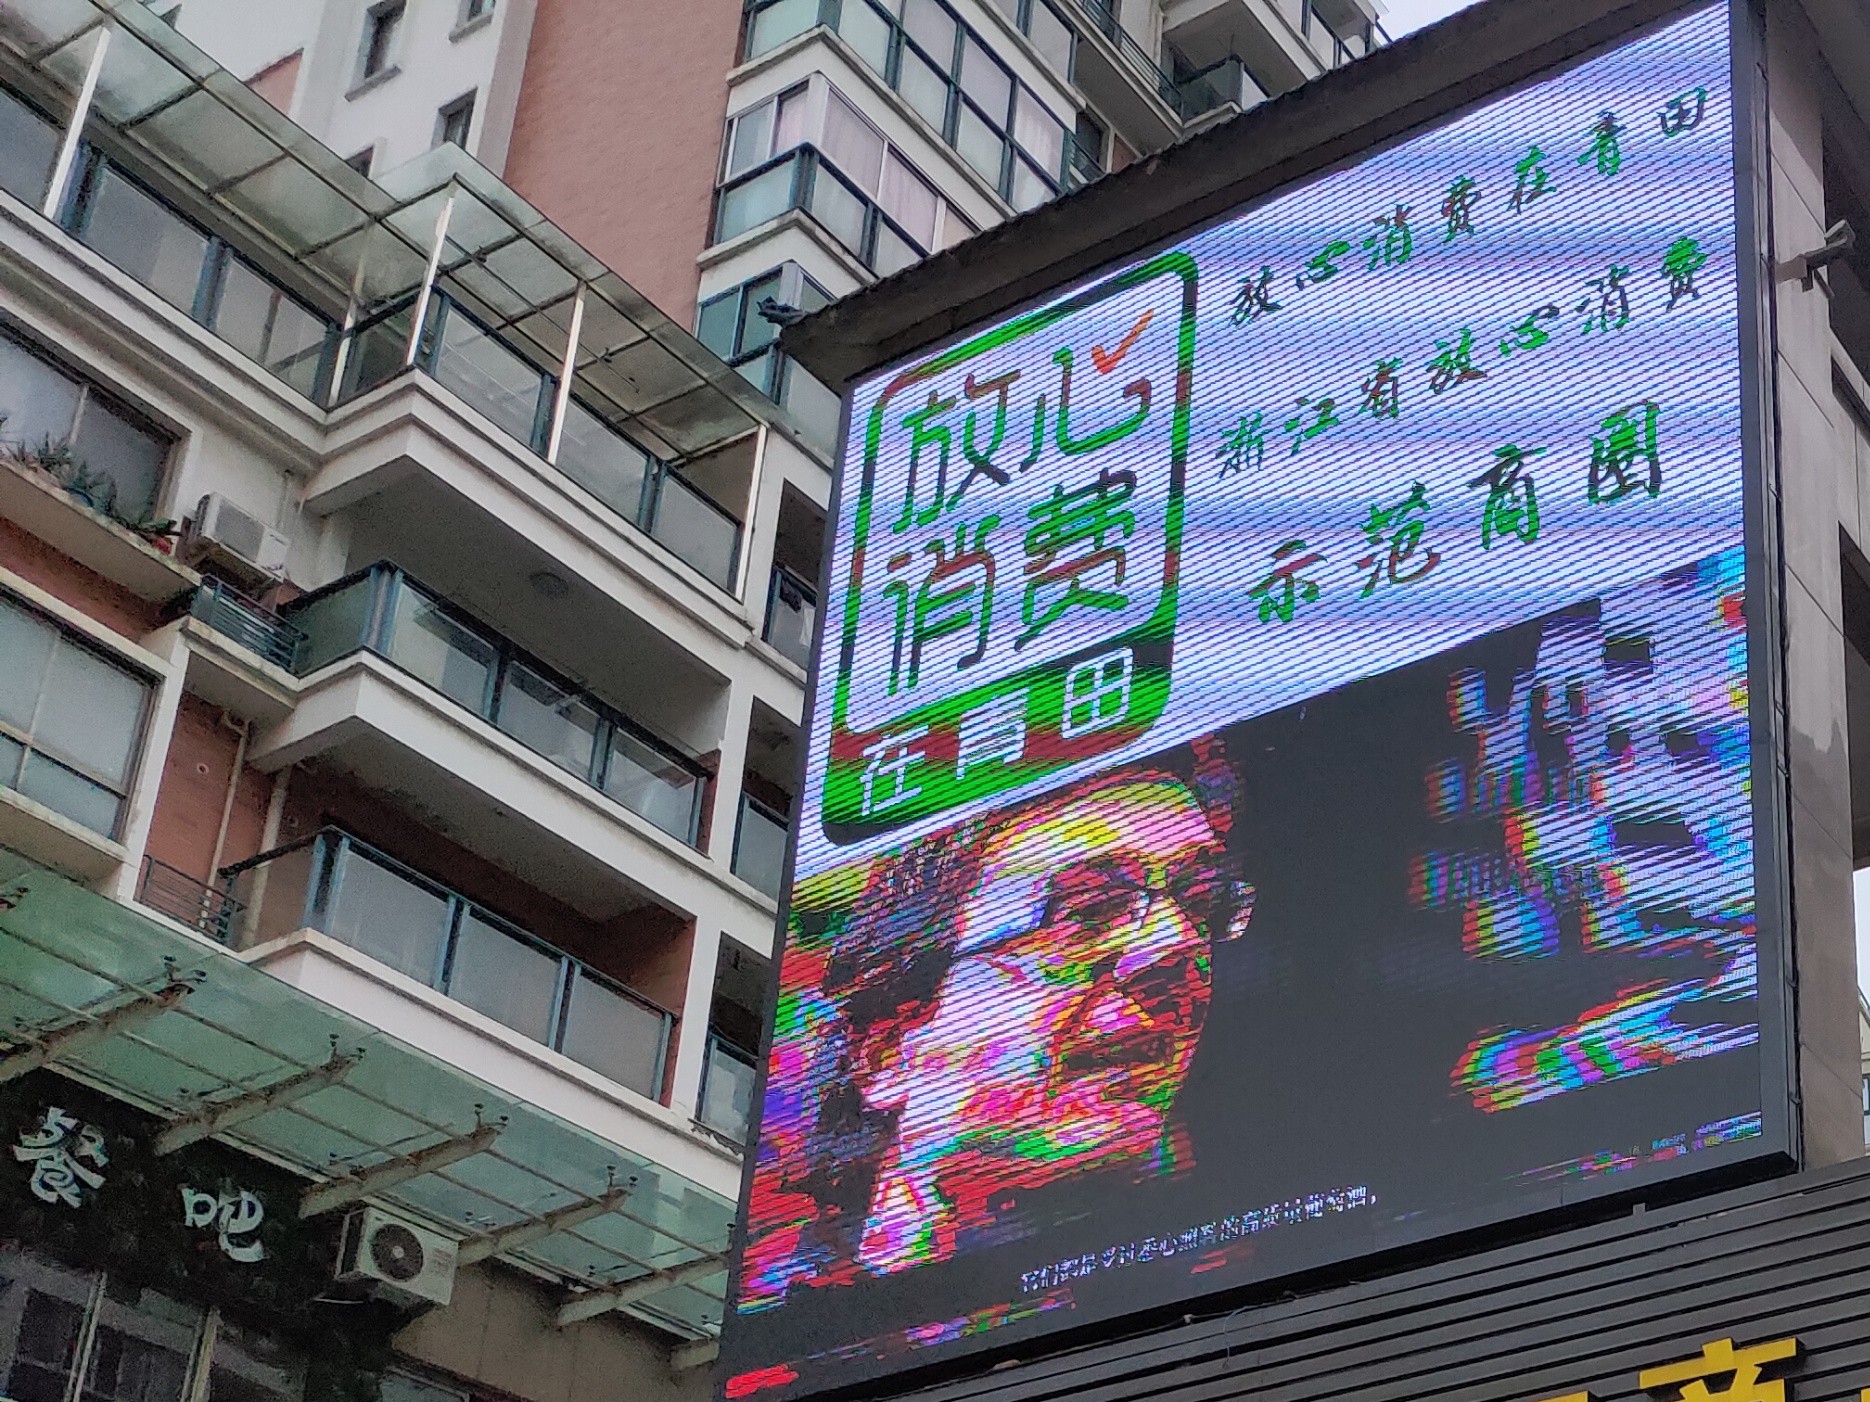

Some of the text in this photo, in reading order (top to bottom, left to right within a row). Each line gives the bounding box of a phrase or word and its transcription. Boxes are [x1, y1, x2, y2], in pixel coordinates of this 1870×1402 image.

[1228, 86, 1707, 326] 放心消费在青田
[902, 345, 1152, 533] 放心
[1213, 236, 1706, 480] 浙江省放心消费
[883, 470, 1137, 699] 消费
[1249, 399, 1661, 626] 示范商圈
[859, 647, 1134, 817] 在青田
